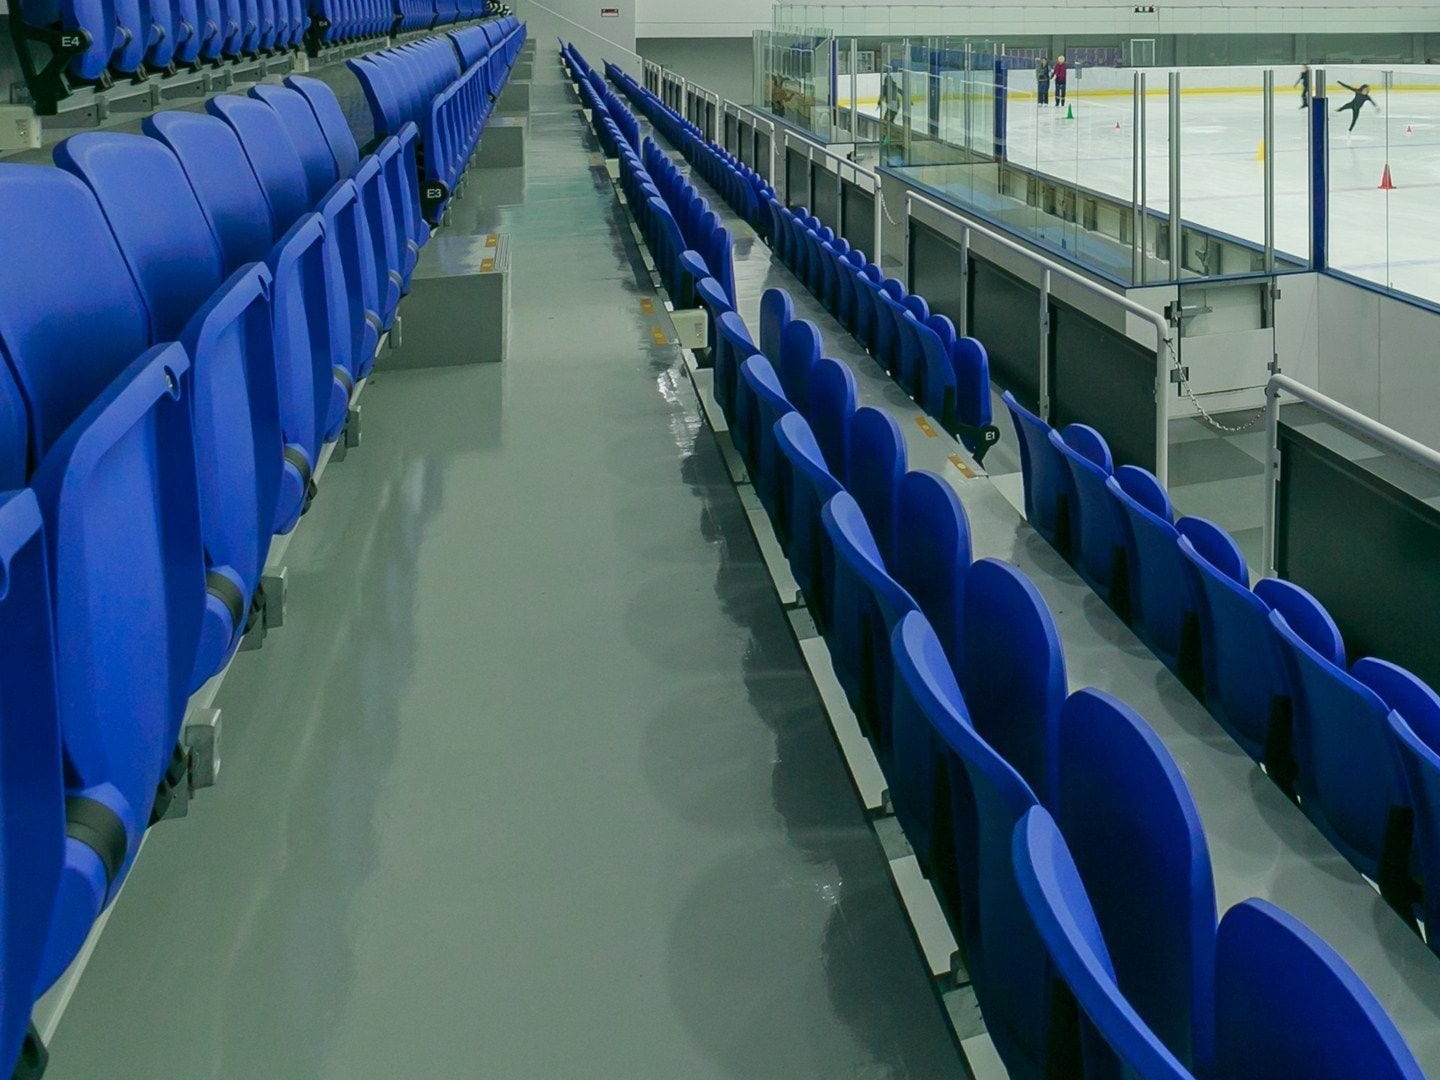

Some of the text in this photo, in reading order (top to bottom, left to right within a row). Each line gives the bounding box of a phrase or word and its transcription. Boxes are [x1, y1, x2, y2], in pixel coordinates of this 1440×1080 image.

[62, 36, 80, 47] E4
[427, 188, 442, 198] E3
[985, 431, 995, 440] E1
